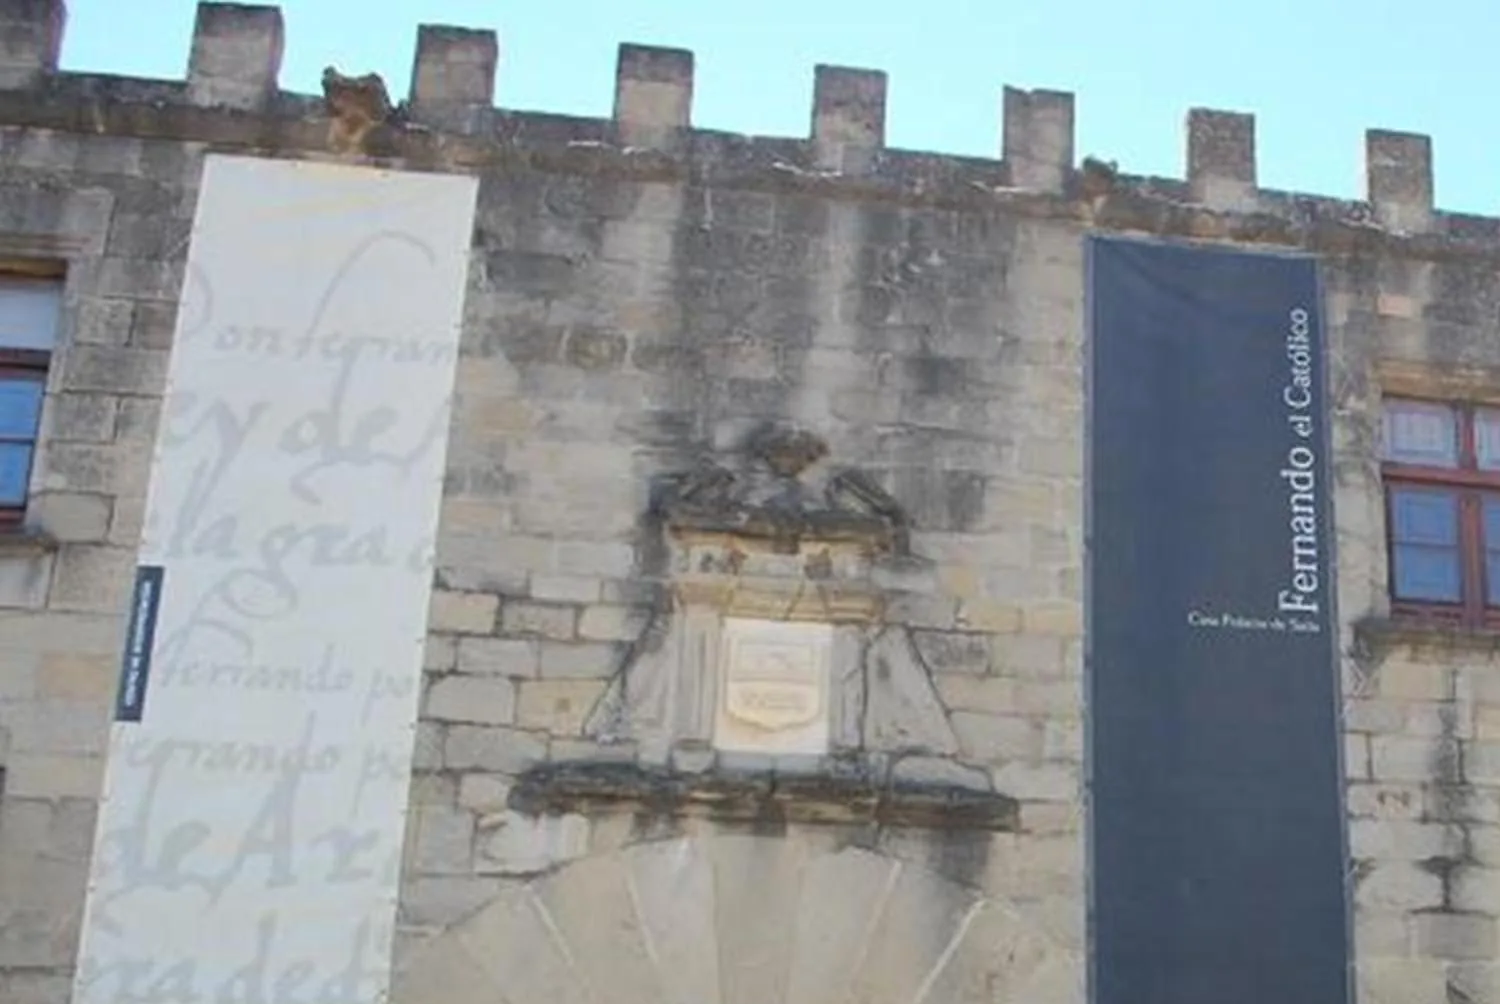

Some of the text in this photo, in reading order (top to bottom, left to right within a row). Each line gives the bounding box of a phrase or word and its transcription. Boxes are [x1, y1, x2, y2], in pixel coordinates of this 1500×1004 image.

[1279, 307, 1320, 614] Fernando el Católico
